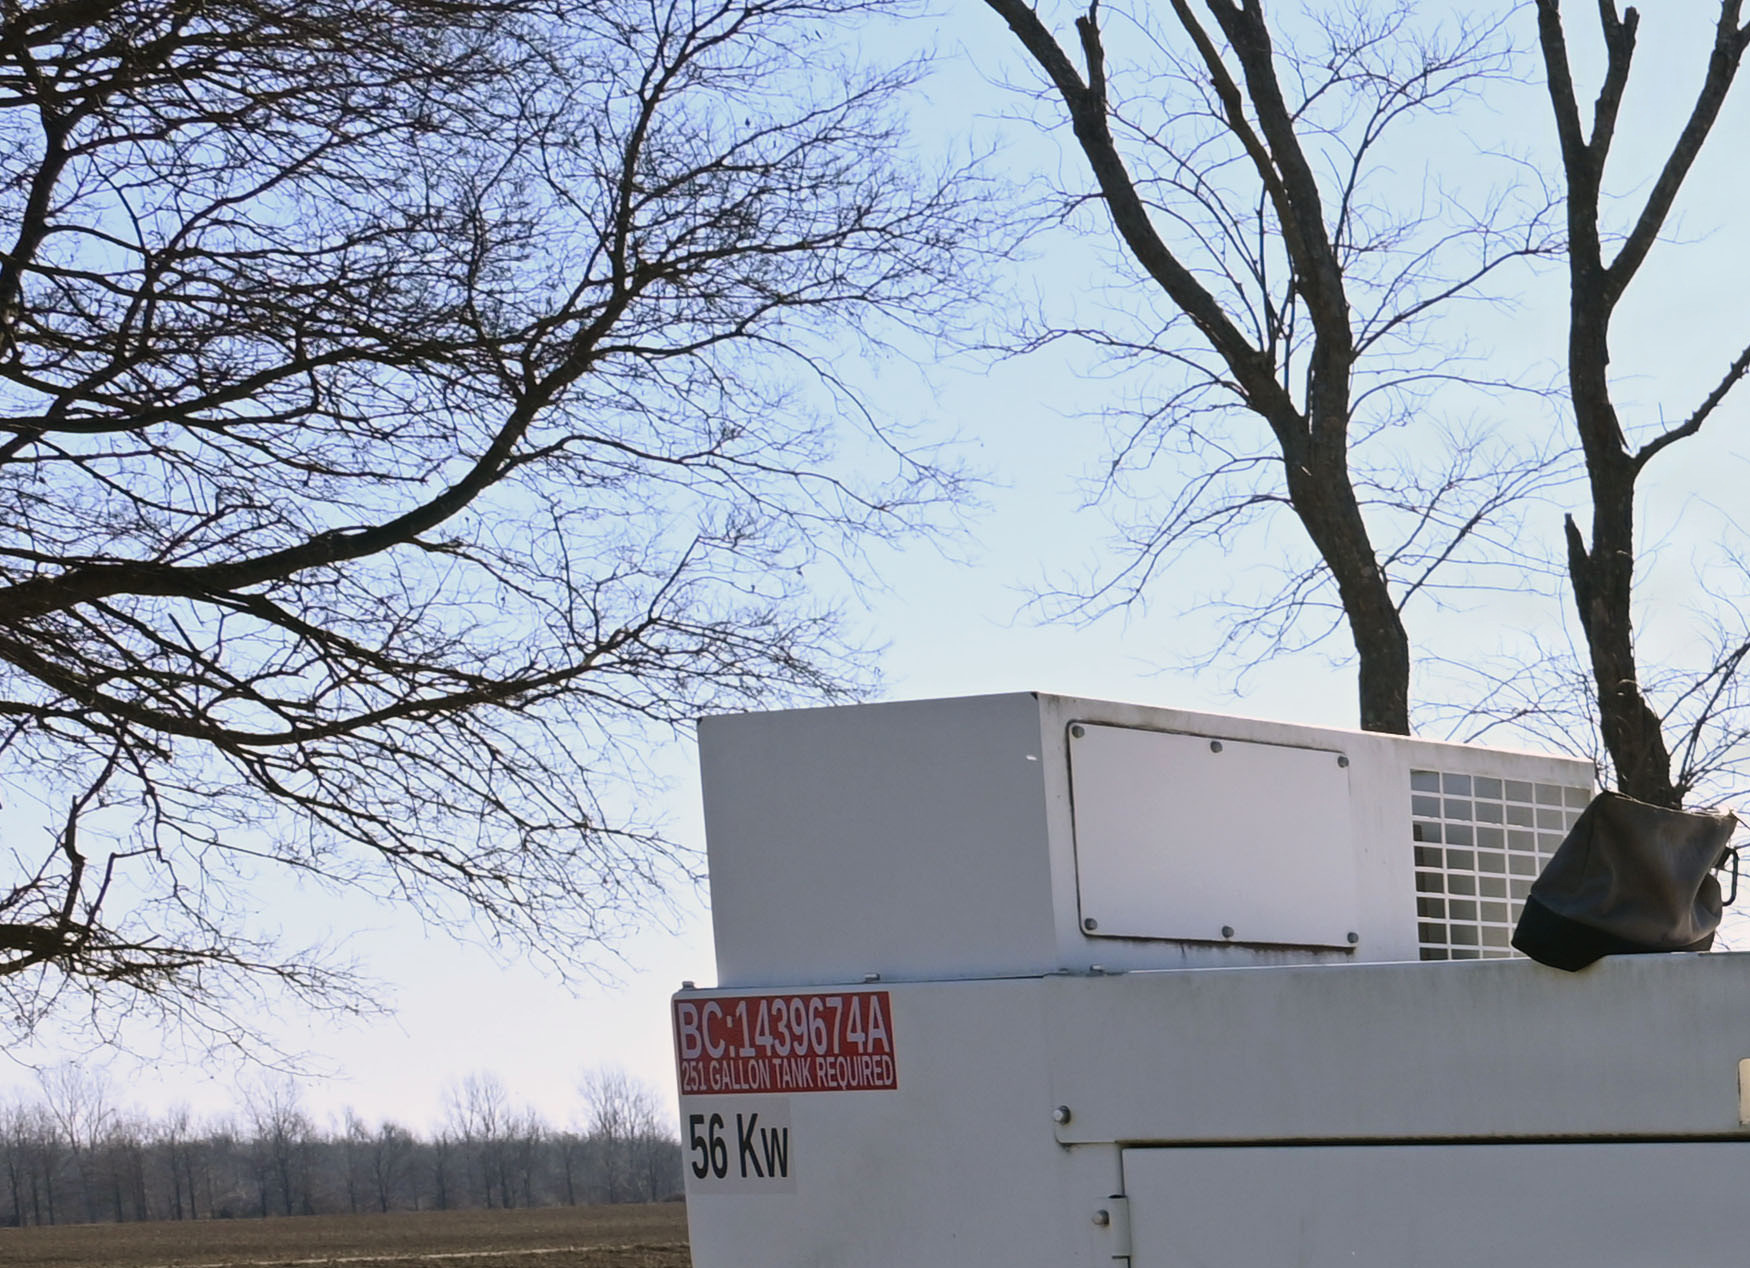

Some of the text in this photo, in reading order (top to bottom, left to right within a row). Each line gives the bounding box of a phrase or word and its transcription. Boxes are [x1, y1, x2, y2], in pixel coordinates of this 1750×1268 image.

[678, 995, 891, 1060] BC:1439674A
[682, 1055, 894, 1091] 251 GALLON TANK REQUIRED
[689, 1113, 728, 1179] 56
